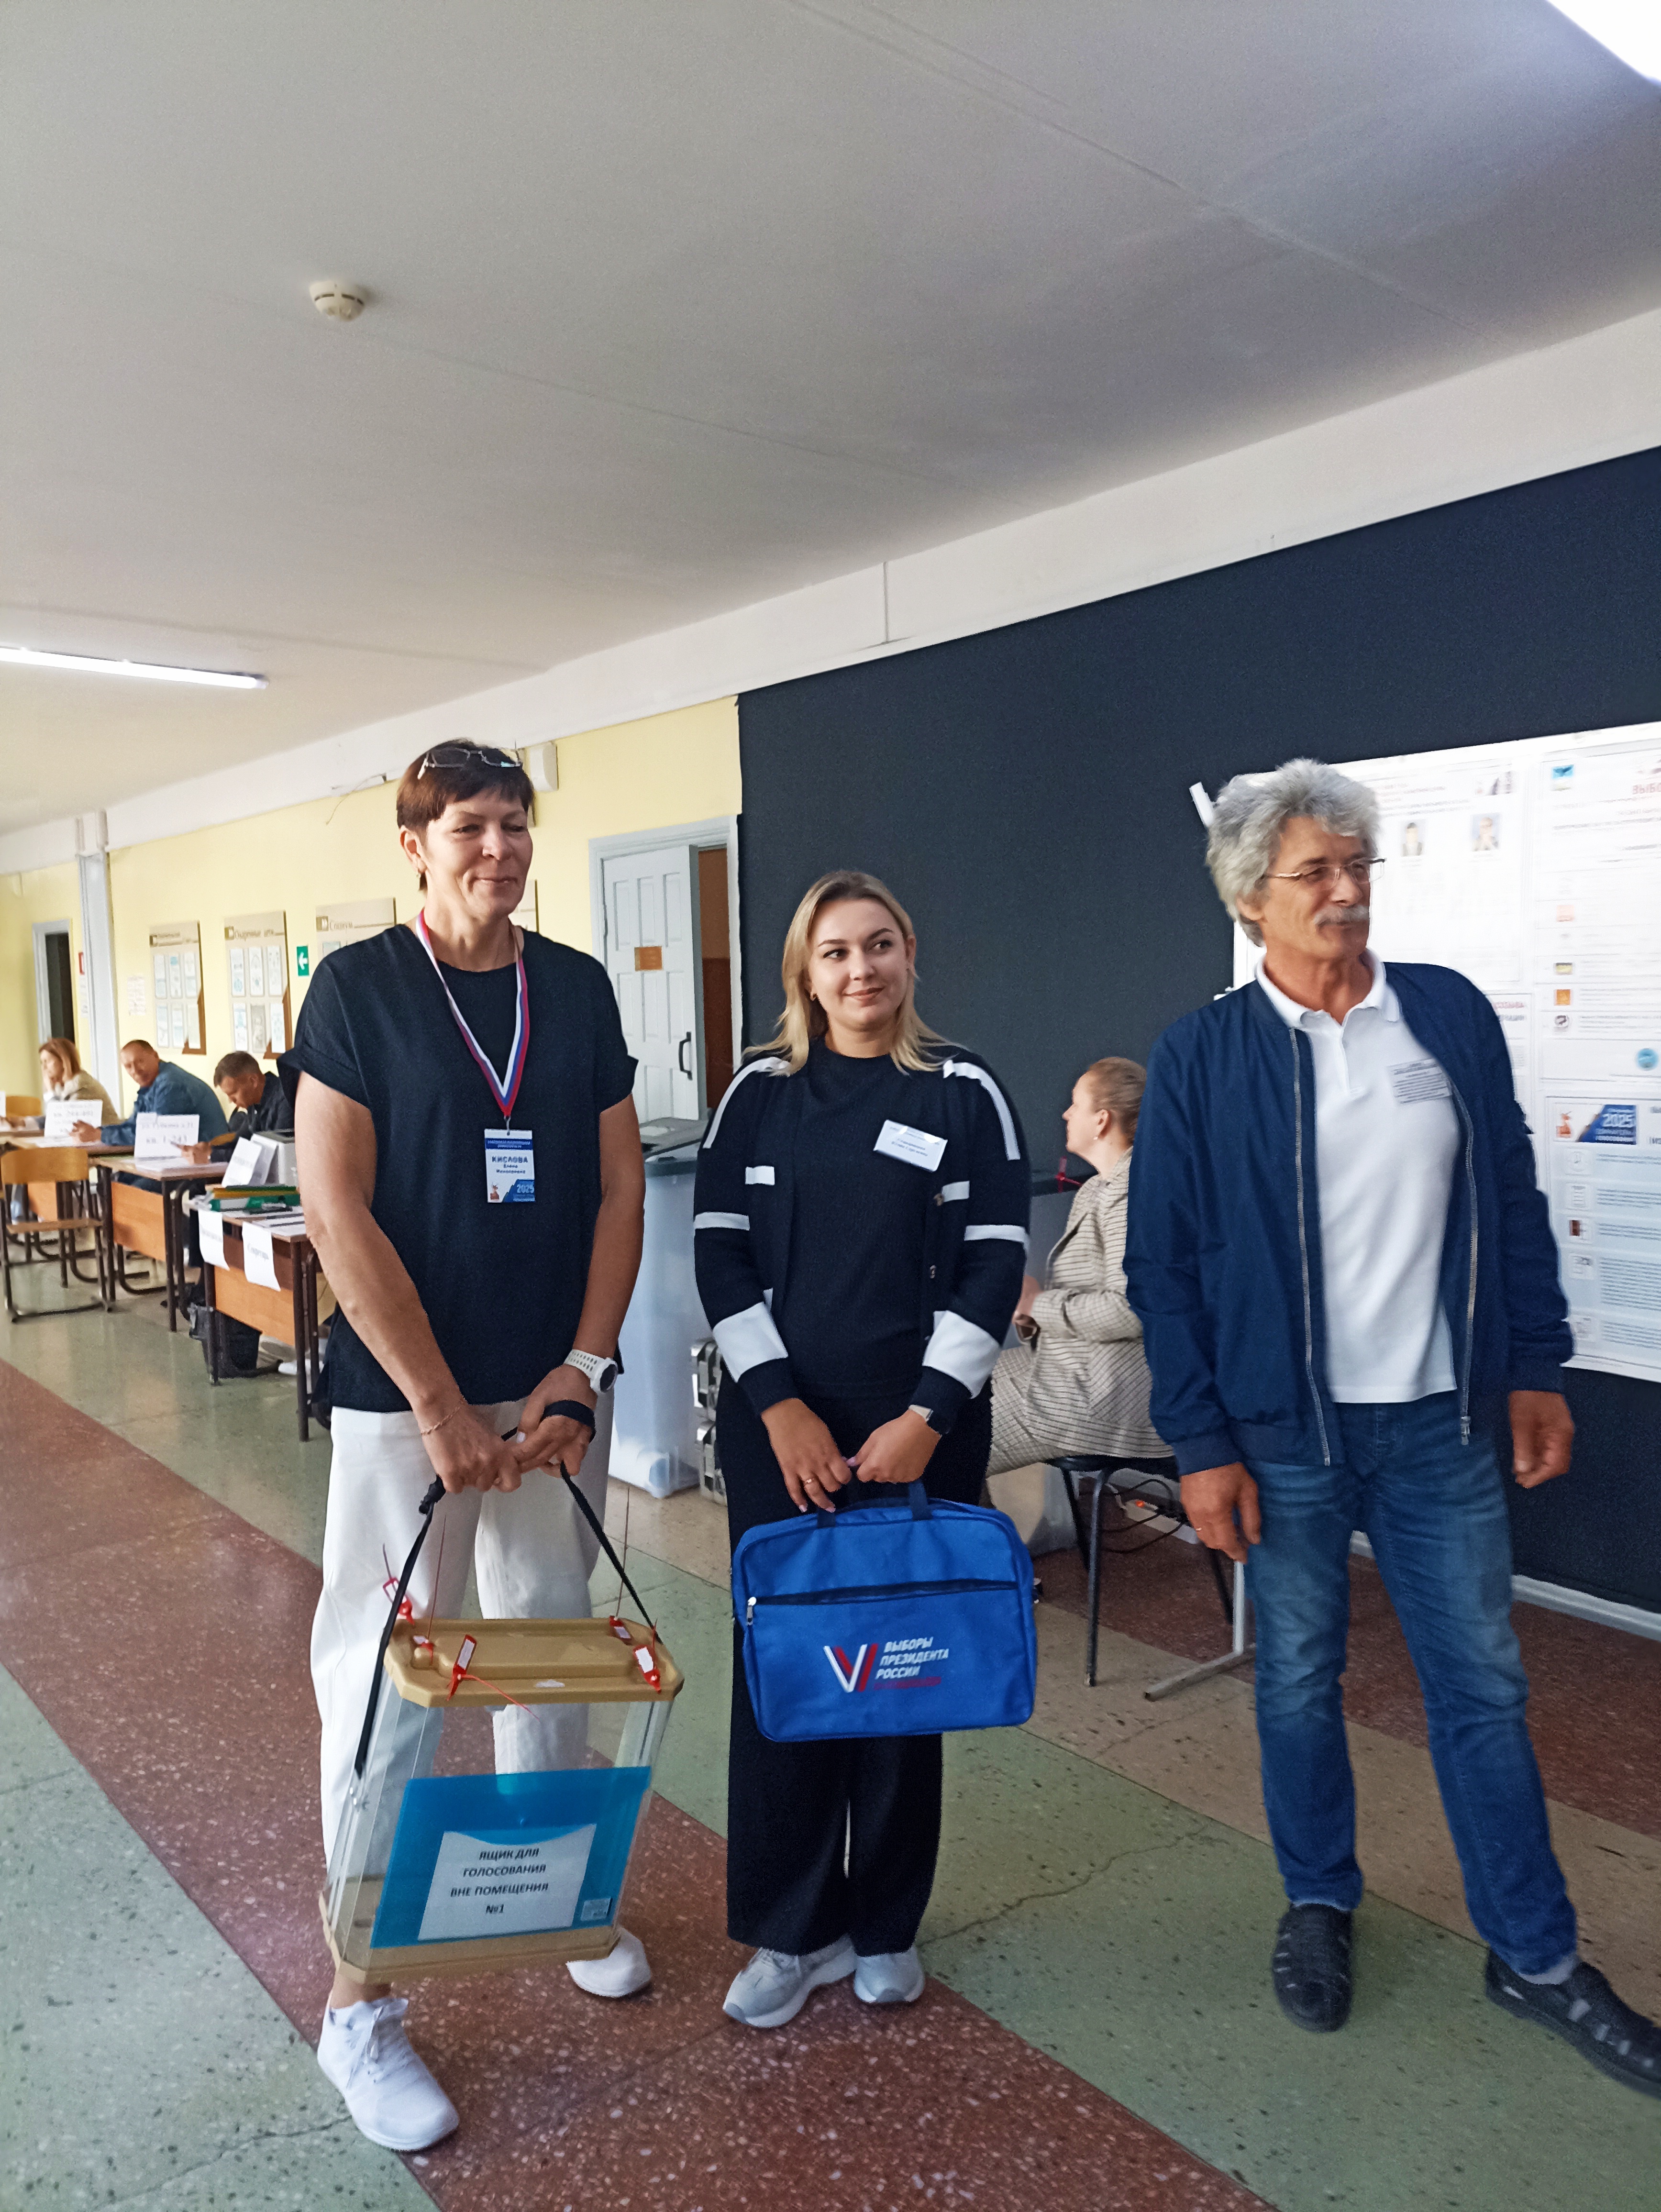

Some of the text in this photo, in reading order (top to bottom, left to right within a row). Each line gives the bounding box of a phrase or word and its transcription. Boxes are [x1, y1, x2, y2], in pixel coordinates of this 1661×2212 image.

[1602, 1114, 1636, 1128] 2025
[884, 1637, 933, 1653] ВЫБОРЫ
[879, 1648, 949, 1666] ПРЕЗИДЕНТА
[875, 1665, 920, 1680] РОССИИ
[479, 1848, 540, 1862] ЯЩИК ДЛЯ
[463, 1864, 546, 1878] ГОЛОСОВАНИЯ
[450, 1883, 549, 1898] ВНЕ ПОМЕЩЕНИЯ
[486, 1904, 504, 1914] №1
